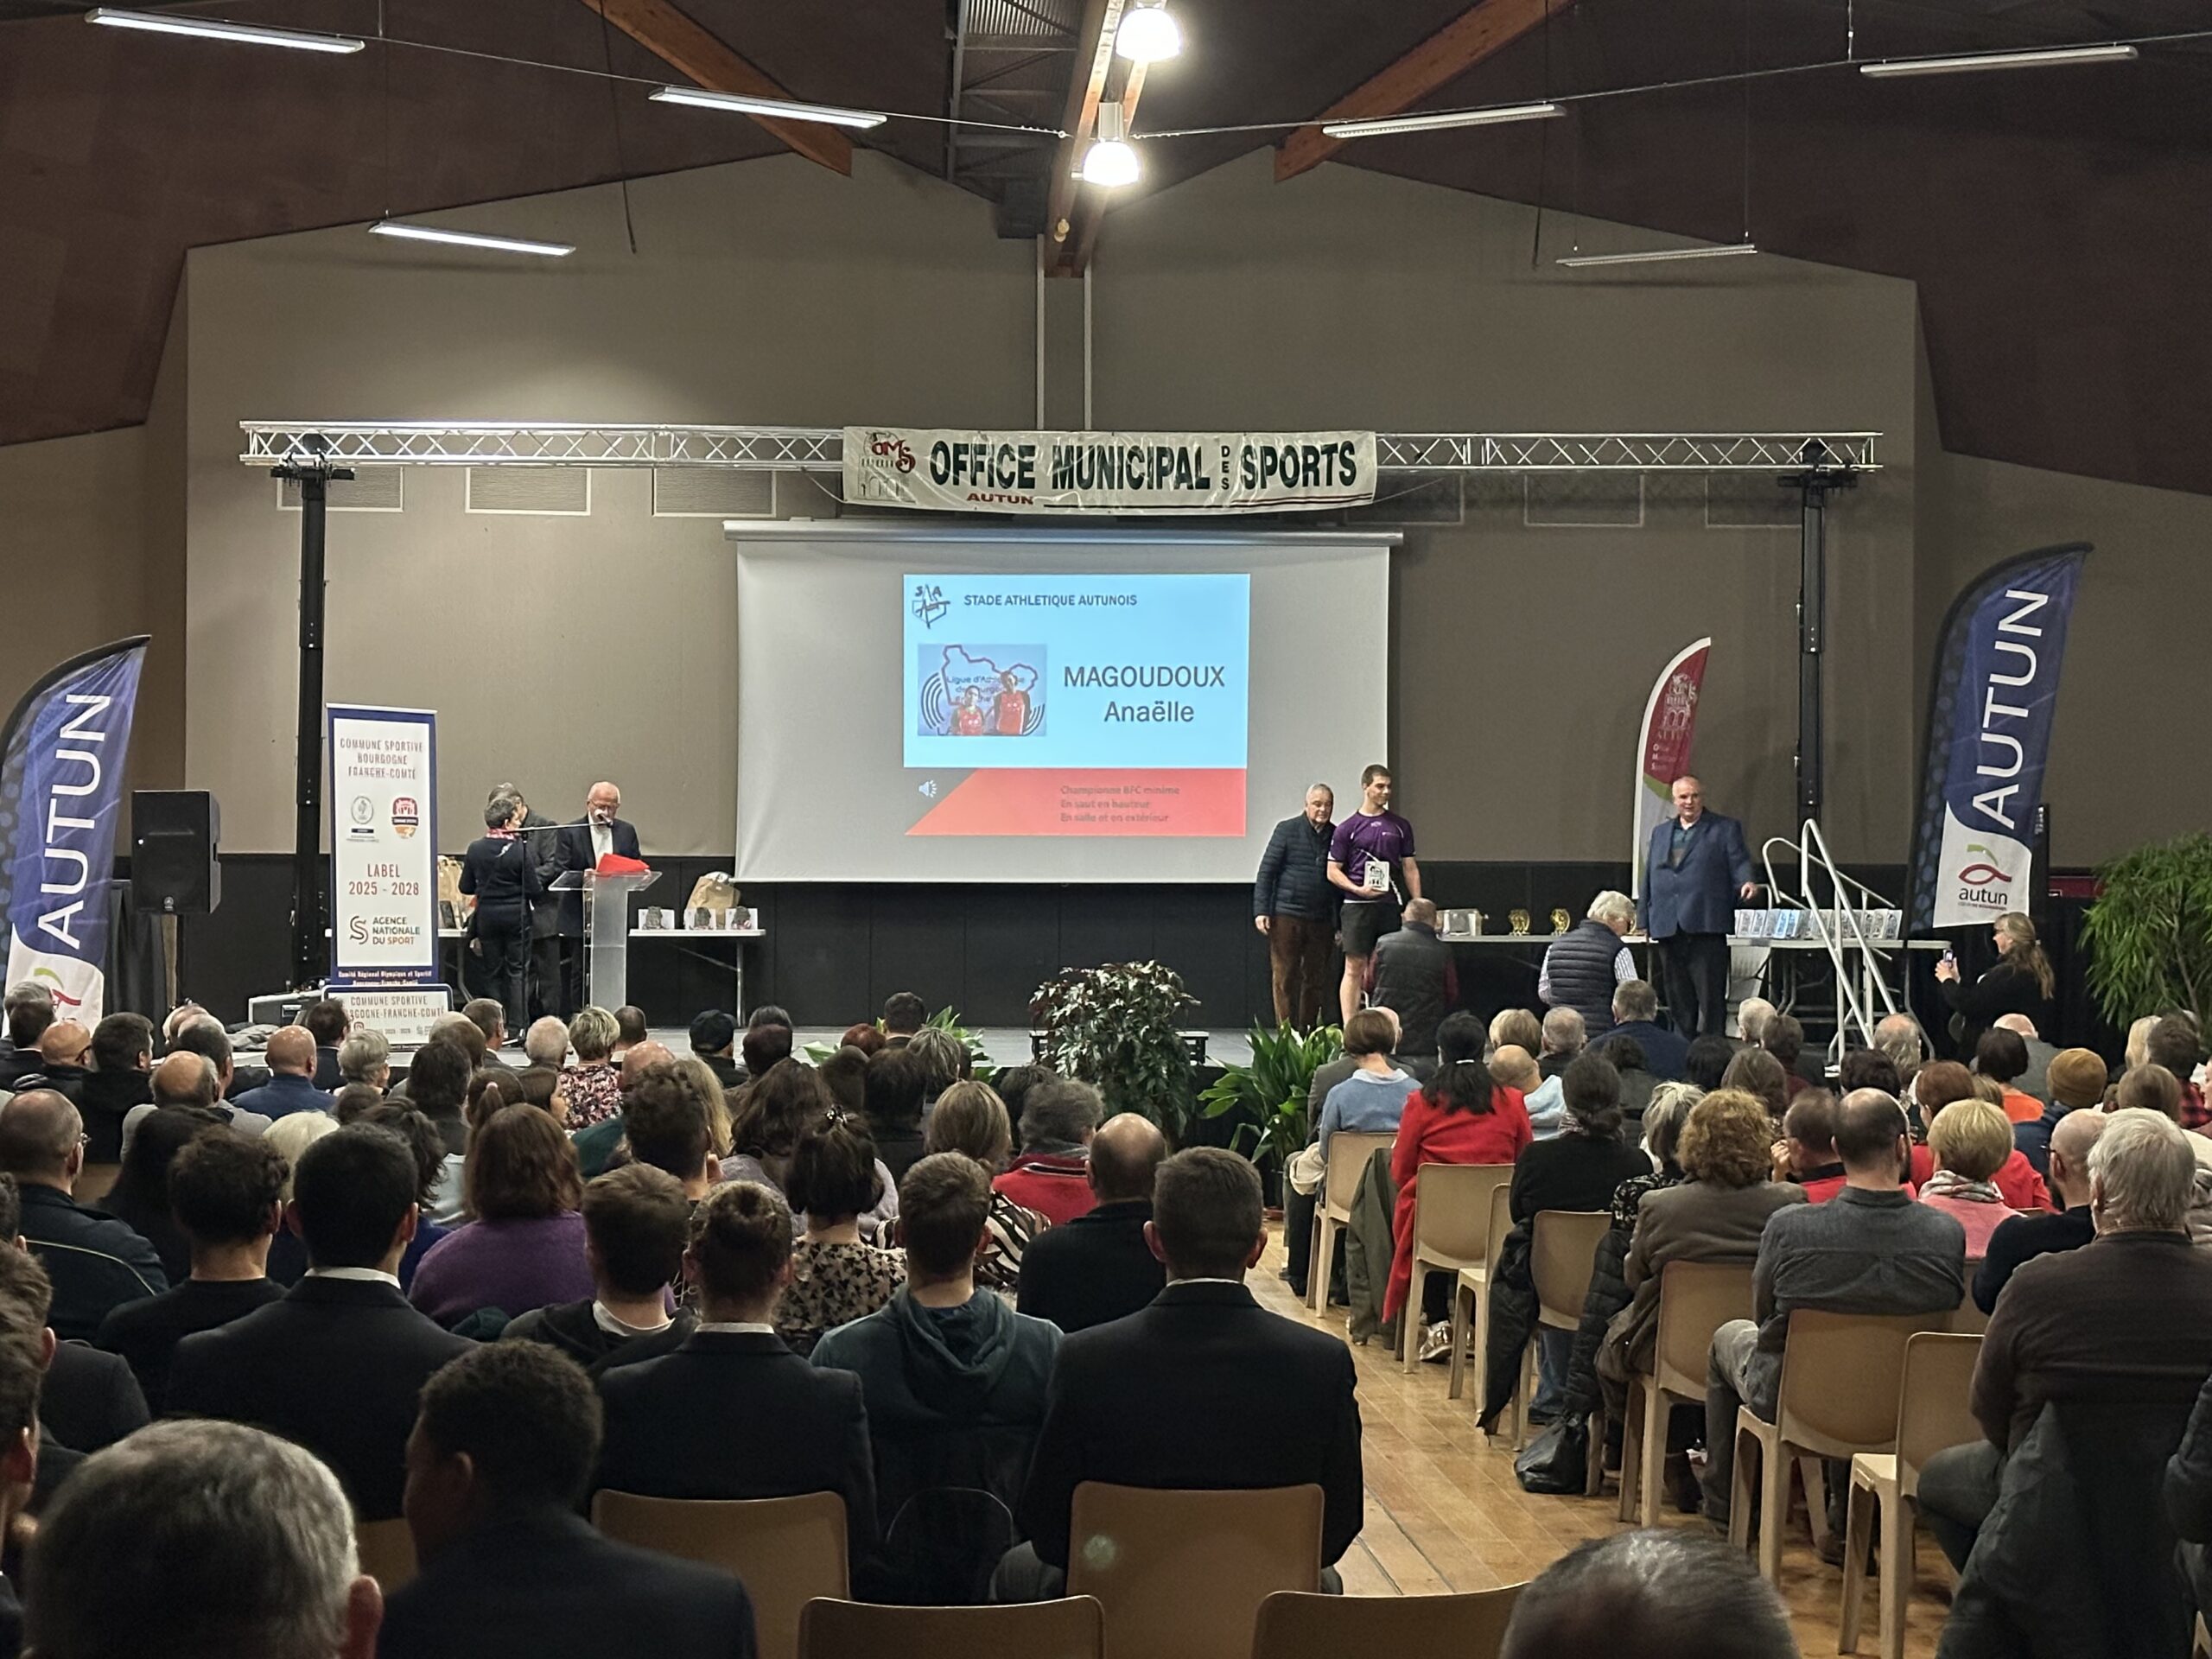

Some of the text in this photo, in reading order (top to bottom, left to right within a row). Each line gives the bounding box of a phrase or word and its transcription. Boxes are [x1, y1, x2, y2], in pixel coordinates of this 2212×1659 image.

[930, 441, 1036, 489] OFFICE
[1051, 444, 1211, 490] MUNICIPAL
[1240, 441, 1357, 490] SPORTS
[967, 493, 1034, 505] AUTUN
[963, 594, 1138, 607] STADE ATHLETIQUE AUTUNOIS
[1064, 665, 1225, 688] MAGOUDOUX
[1103, 700, 1195, 723] Anaëlle
[1972, 589, 2049, 830] AUTUN
[340, 738, 423, 753] COMMUNE SPORTIVE
[357, 753, 408, 766] BOURGOGNE
[38, 694, 111, 950] AUTUN
[367, 863, 400, 877] LABEL
[349, 881, 378, 895] 2025
[391, 881, 420, 895] 2028
[1959, 887, 2008, 905] autun
[372, 916, 407, 925] AGENCE
[372, 926, 421, 936] NATIONALE
[372, 936, 415, 945] DU SPORT
[350, 995, 429, 1007] COMMUNE SPORTIVE
